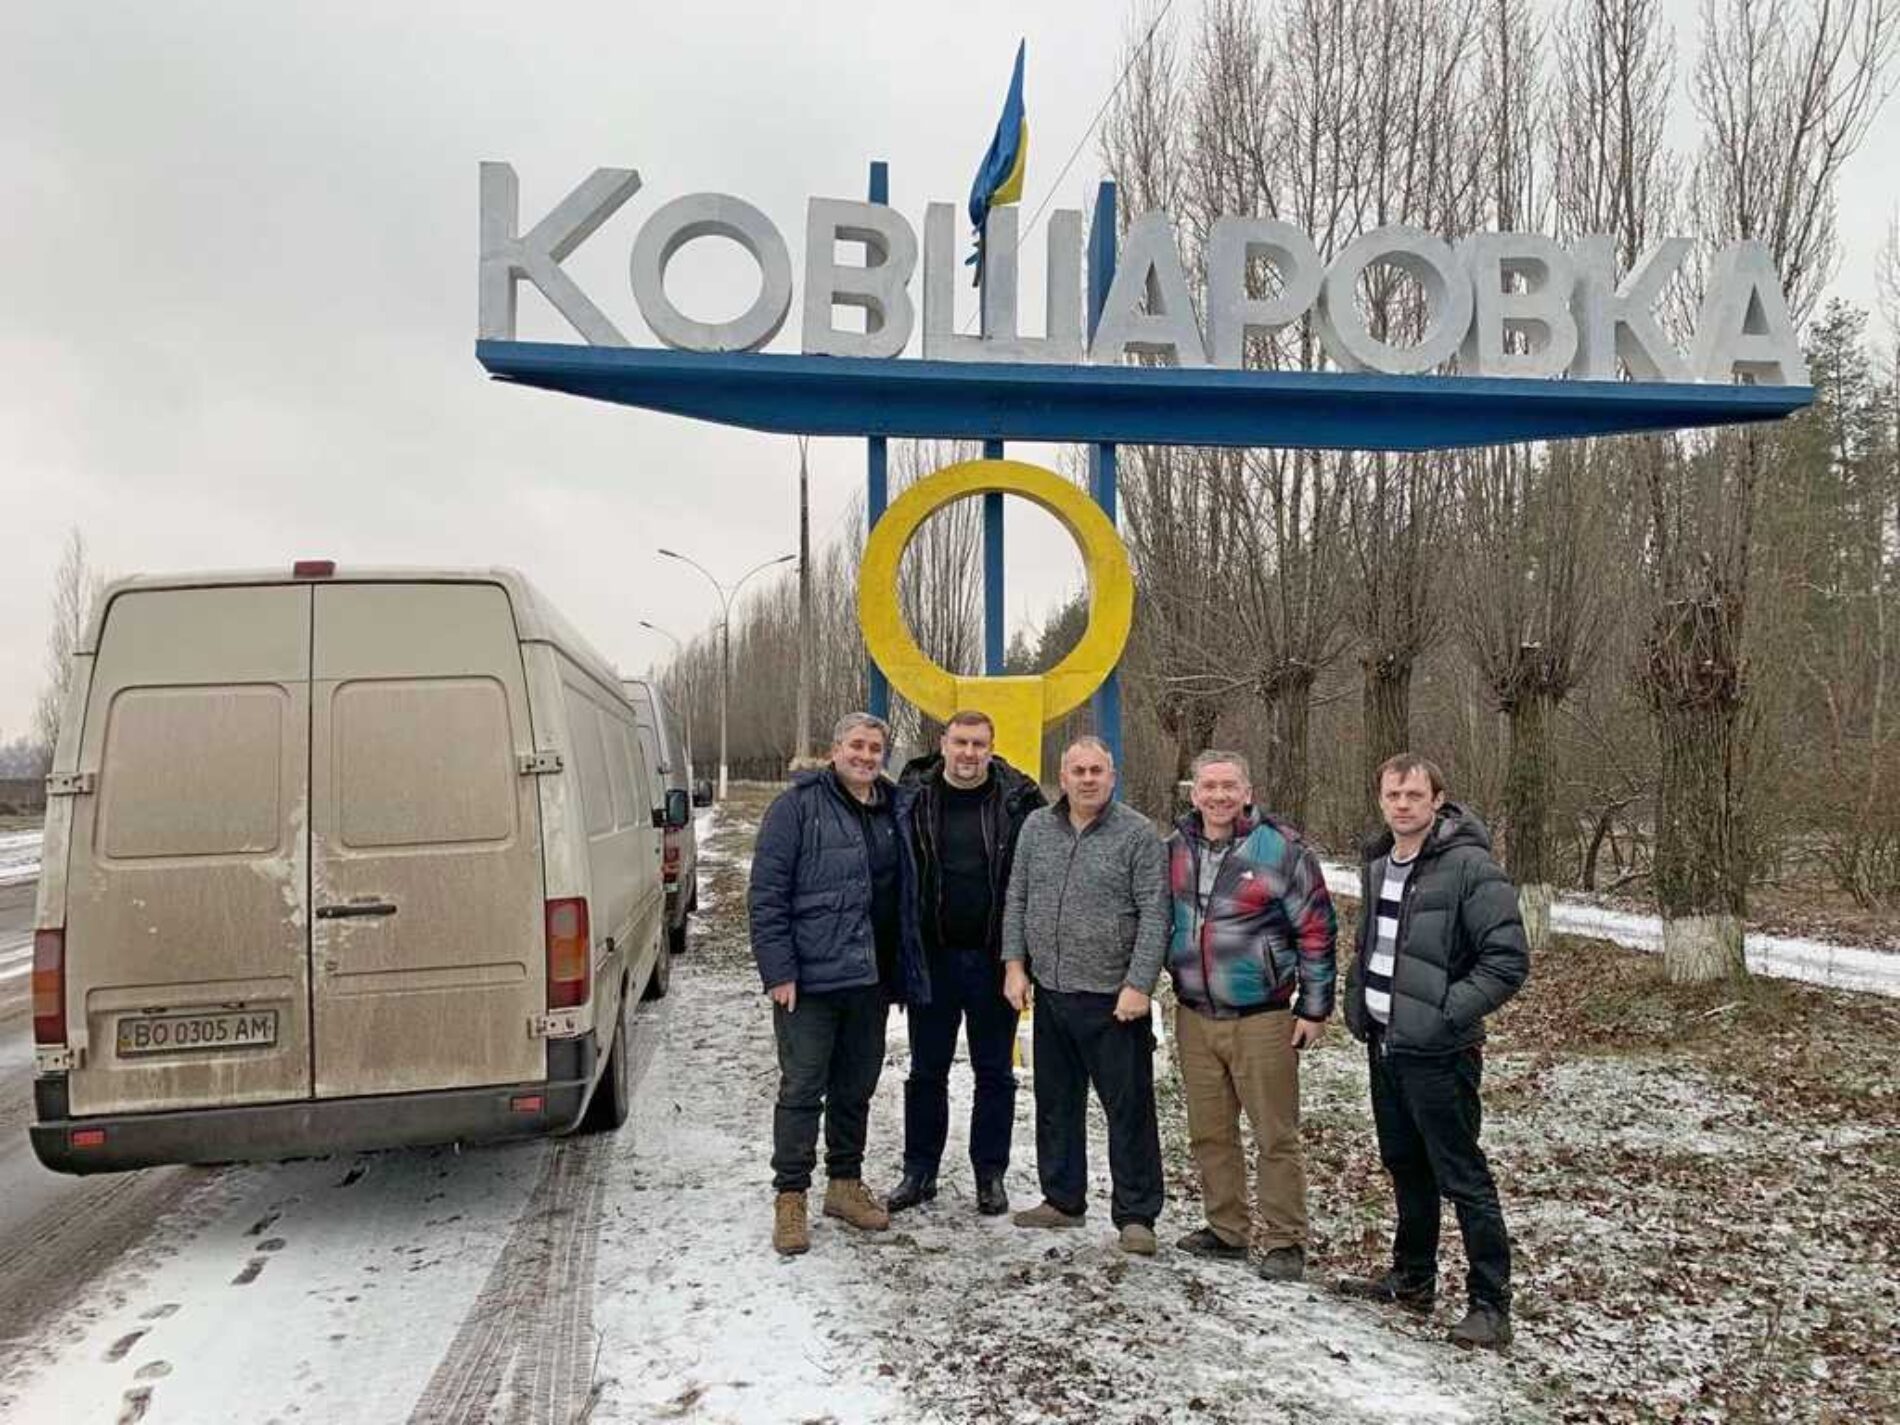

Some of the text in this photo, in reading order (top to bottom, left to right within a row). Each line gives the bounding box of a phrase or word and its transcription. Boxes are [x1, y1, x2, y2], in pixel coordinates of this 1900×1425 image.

[478, 161, 1808, 386] КОВШАРОВКА
[134, 1017, 269, 1047] BO 0305 AM
